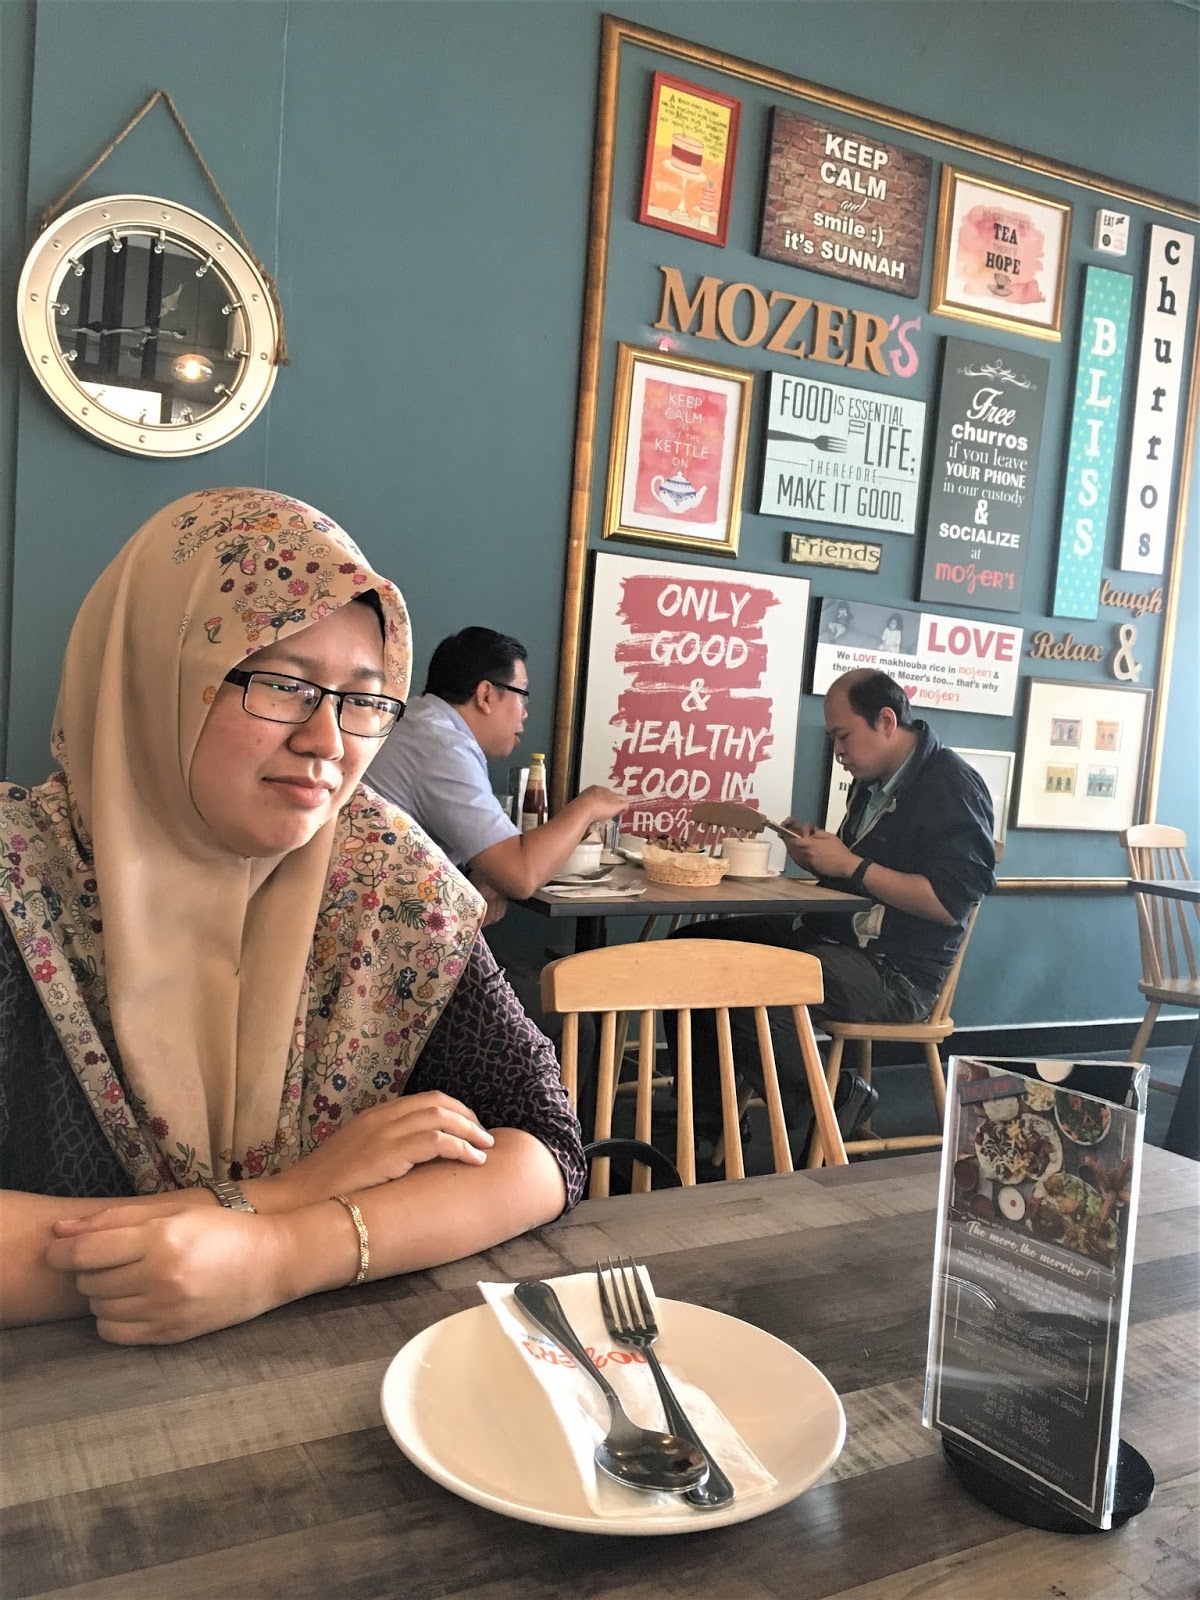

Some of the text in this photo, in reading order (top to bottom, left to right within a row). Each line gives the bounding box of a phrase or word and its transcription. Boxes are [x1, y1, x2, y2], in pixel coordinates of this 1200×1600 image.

[825, 133, 888, 171] KEEP
[820, 162, 887, 200] CALM
[841, 197, 867, 212] and
[814, 212, 865, 239] smile
[994, 223, 1018, 245] TEA
[1104, 215, 1114, 227] EAT
[785, 230, 905, 279] it's SUNNAH
[985, 251, 1020, 275] HOPE
[654, 265, 921, 378] MOZER'S
[669, 392, 703, 409] KEEP
[780, 379, 904, 427] FOOD IS ESSENTIAL
[967, 387, 1016, 427] Free
[1138, 240, 1180, 557] churros
[664, 407, 703, 425] CALM
[655, 437, 708, 459] KETTLE
[863, 422, 917, 476] LIFE;
[951, 421, 1028, 452] churros
[1074, 317, 1116, 556] BLISS
[672, 456, 689, 468] ON
[949, 440, 1028, 471] if you leave
[946, 461, 1026, 489] YOUR PHONE
[777, 474, 905, 523] MAKE IT GOOD.
[943, 480, 1025, 507] in our custody
[974, 500, 988, 525] &
[793, 537, 879, 562] Friends
[939, 523, 1020, 549] SOCIALIZE
[971, 547, 981, 560] at
[656, 583, 752, 627] ONLY
[1101, 580, 1163, 618] laugh
[650, 631, 748, 669] GOOD
[928, 622, 1015, 662] LOVE
[1030, 622, 1143, 683] Relax &
[837, 650, 850, 660] We
[853, 653, 877, 663] LOVE
[879, 657, 927, 670] makhlouba
[929, 663, 946, 673] rice
[948, 665, 956, 674] in
[994, 670, 999, 679] &
[681, 678, 711, 712] &
[898, 671, 930, 683] Mozer's
[956, 679, 980, 689] that's
[982, 682, 999, 693] why
[617, 719, 767, 762] HEALTHY
[622, 766, 754, 803] FOOD IN
